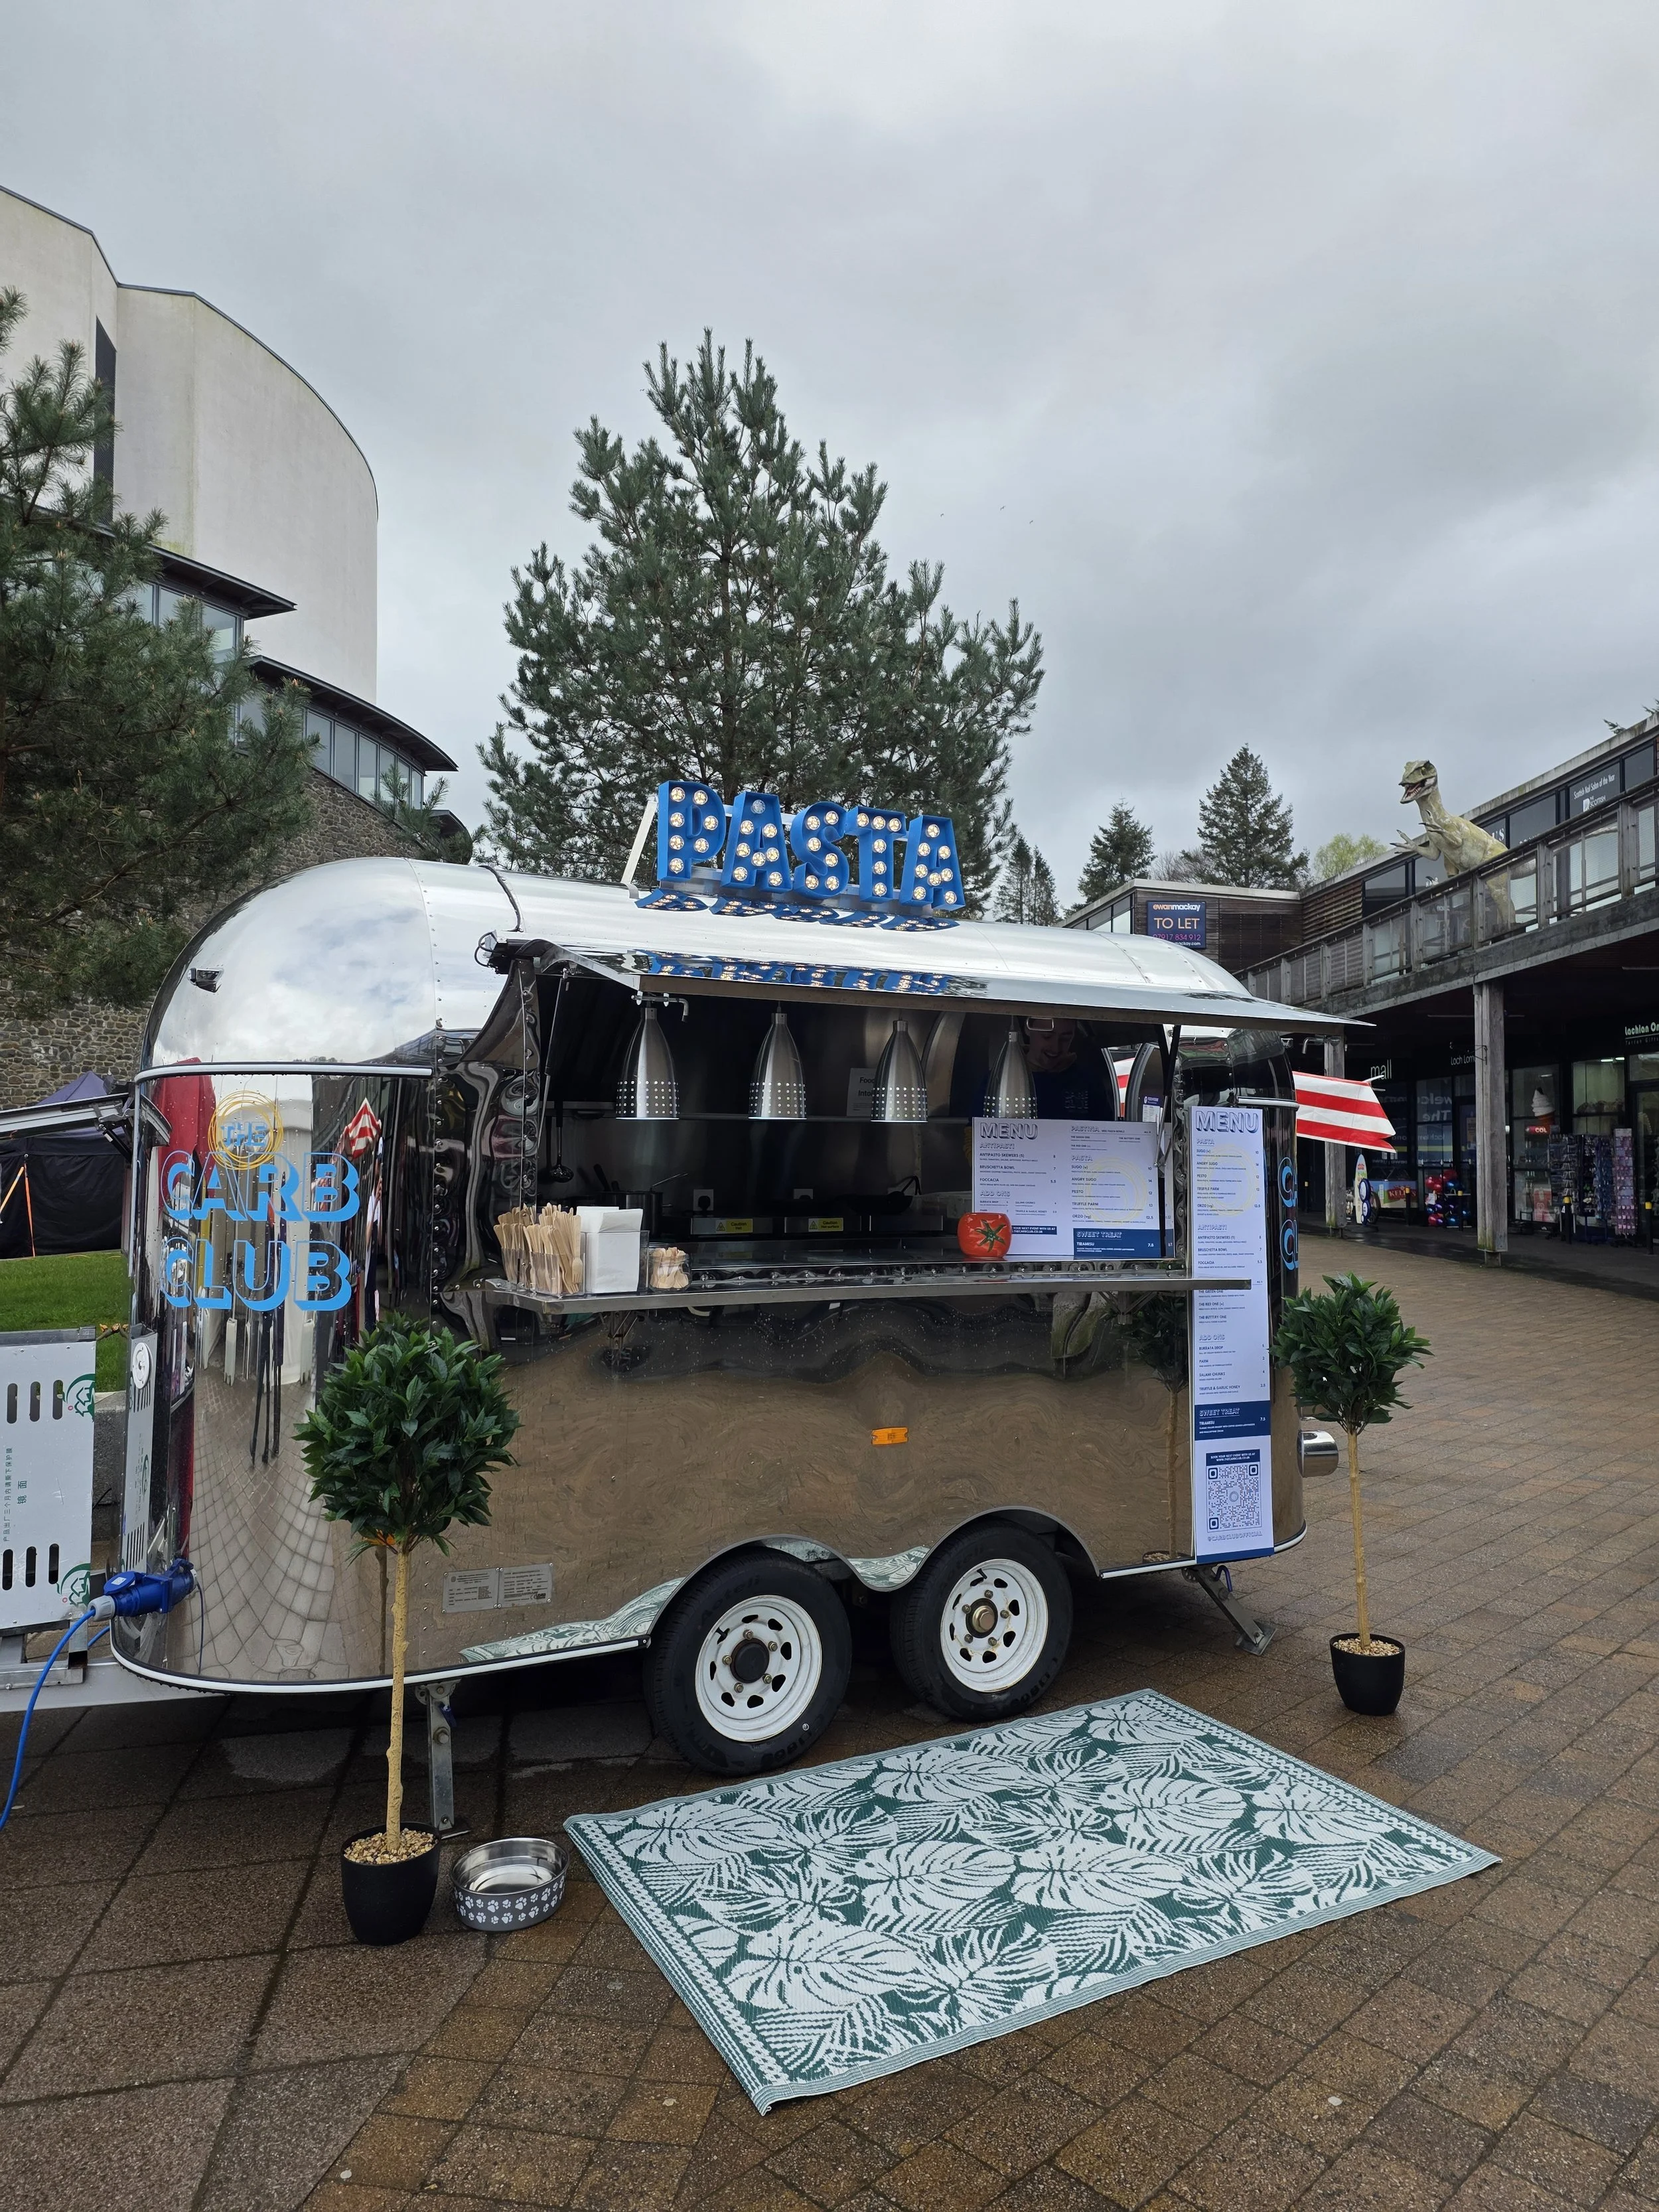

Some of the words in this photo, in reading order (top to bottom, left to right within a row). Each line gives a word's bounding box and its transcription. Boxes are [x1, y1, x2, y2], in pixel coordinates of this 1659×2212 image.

[657, 780, 965, 911] PASTA
[1153, 903, 1200, 912] ewanmackay
[1153, 918, 1174, 929] TO
[1178, 918, 1200, 929] LET
[1370, 1059, 1392, 1080] mall
[979, 1122, 1038, 1140] MENU
[1195, 1110, 1259, 1134] MENU
[221, 1121, 267, 1147] THE
[161, 1150, 360, 1222] CARB
[161, 1236, 352, 1311] CLUB
[1199, 1409, 1220, 1418] SWEET
